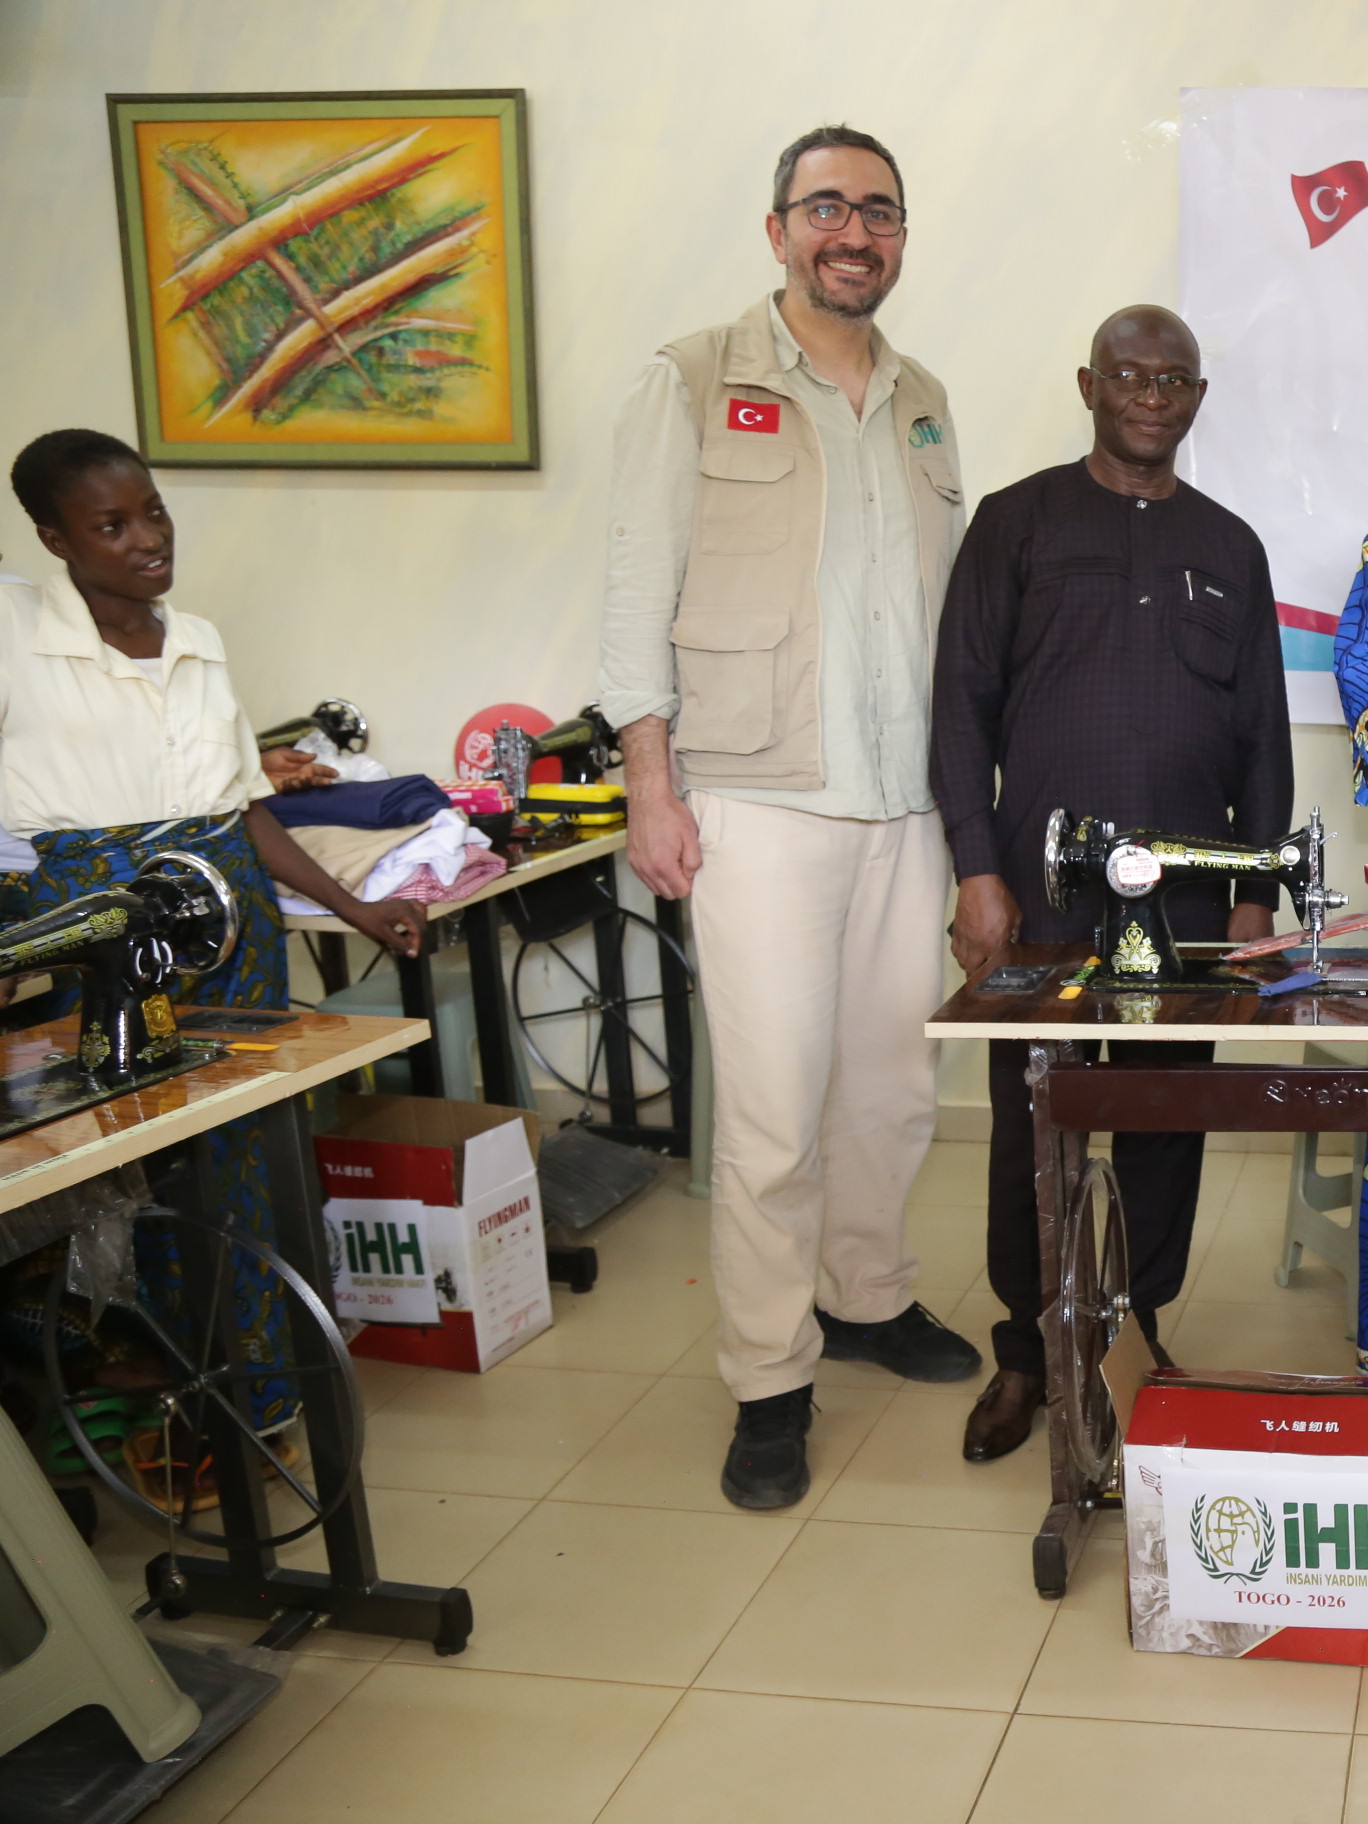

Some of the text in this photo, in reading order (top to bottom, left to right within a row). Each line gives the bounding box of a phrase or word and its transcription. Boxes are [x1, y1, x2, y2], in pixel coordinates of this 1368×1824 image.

[1194, 861, 1229, 869] FLYING
[477, 1196, 531, 1237] FLYINGMAN
[1260, 1419, 1340, 1433] 飞人缝纫机
[1325, 1574, 1367, 1587] YARDIM
[1234, 1591, 1291, 1606] TOGO
[1308, 1595, 1346, 1608] 2026
